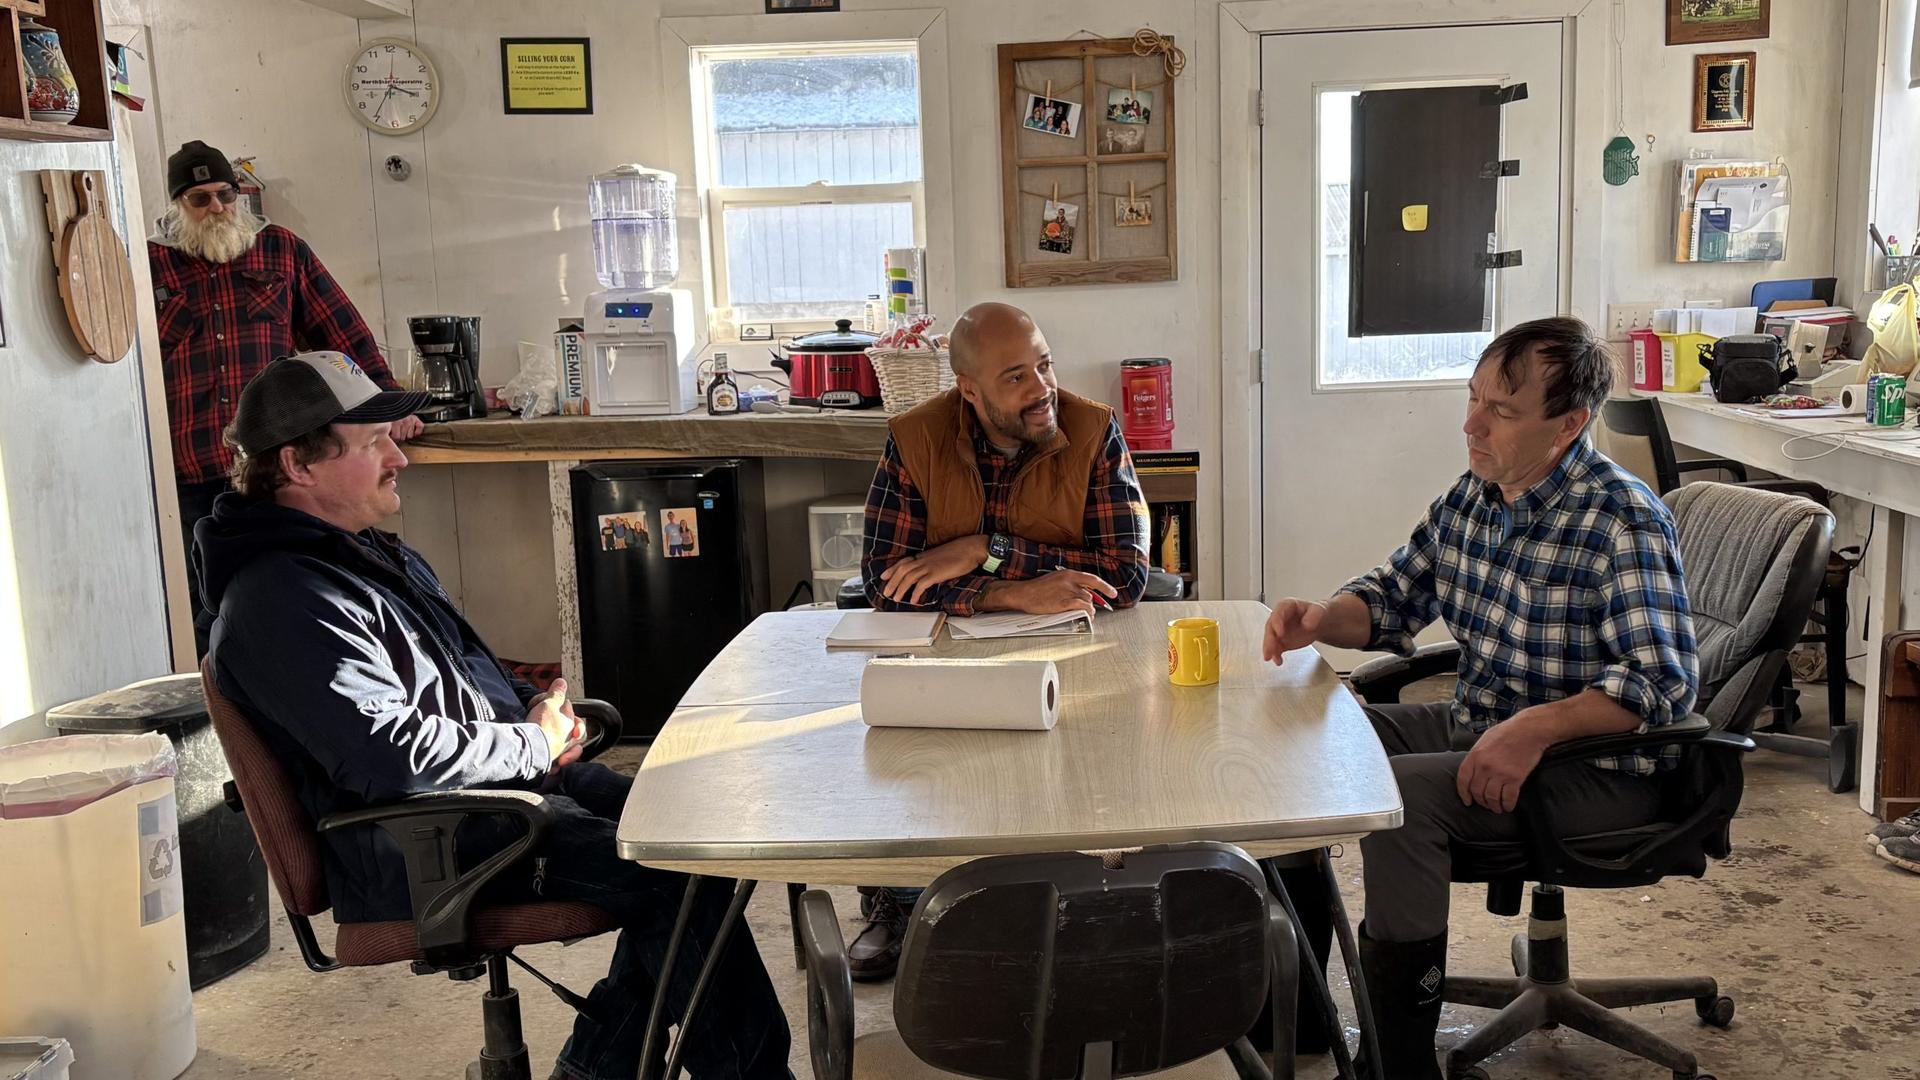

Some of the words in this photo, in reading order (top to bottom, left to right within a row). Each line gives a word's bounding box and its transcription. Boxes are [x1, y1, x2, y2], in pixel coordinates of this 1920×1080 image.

[384, 45, 396, 53] 12
[407, 50, 411, 58] 1
[517, 55, 542, 63] SELLING
[543, 55, 558, 63] YOUR
[559, 55, 576, 63] CORN
[357, 65, 368, 73] 10
[418, 65, 426, 73] 2
[352, 83, 359, 91] 9
[425, 83, 432, 91] 3
[391, 120, 399, 128] 6
[565, 335, 582, 398] PREMIUM
[1133, 394, 1156, 402] Folgers
